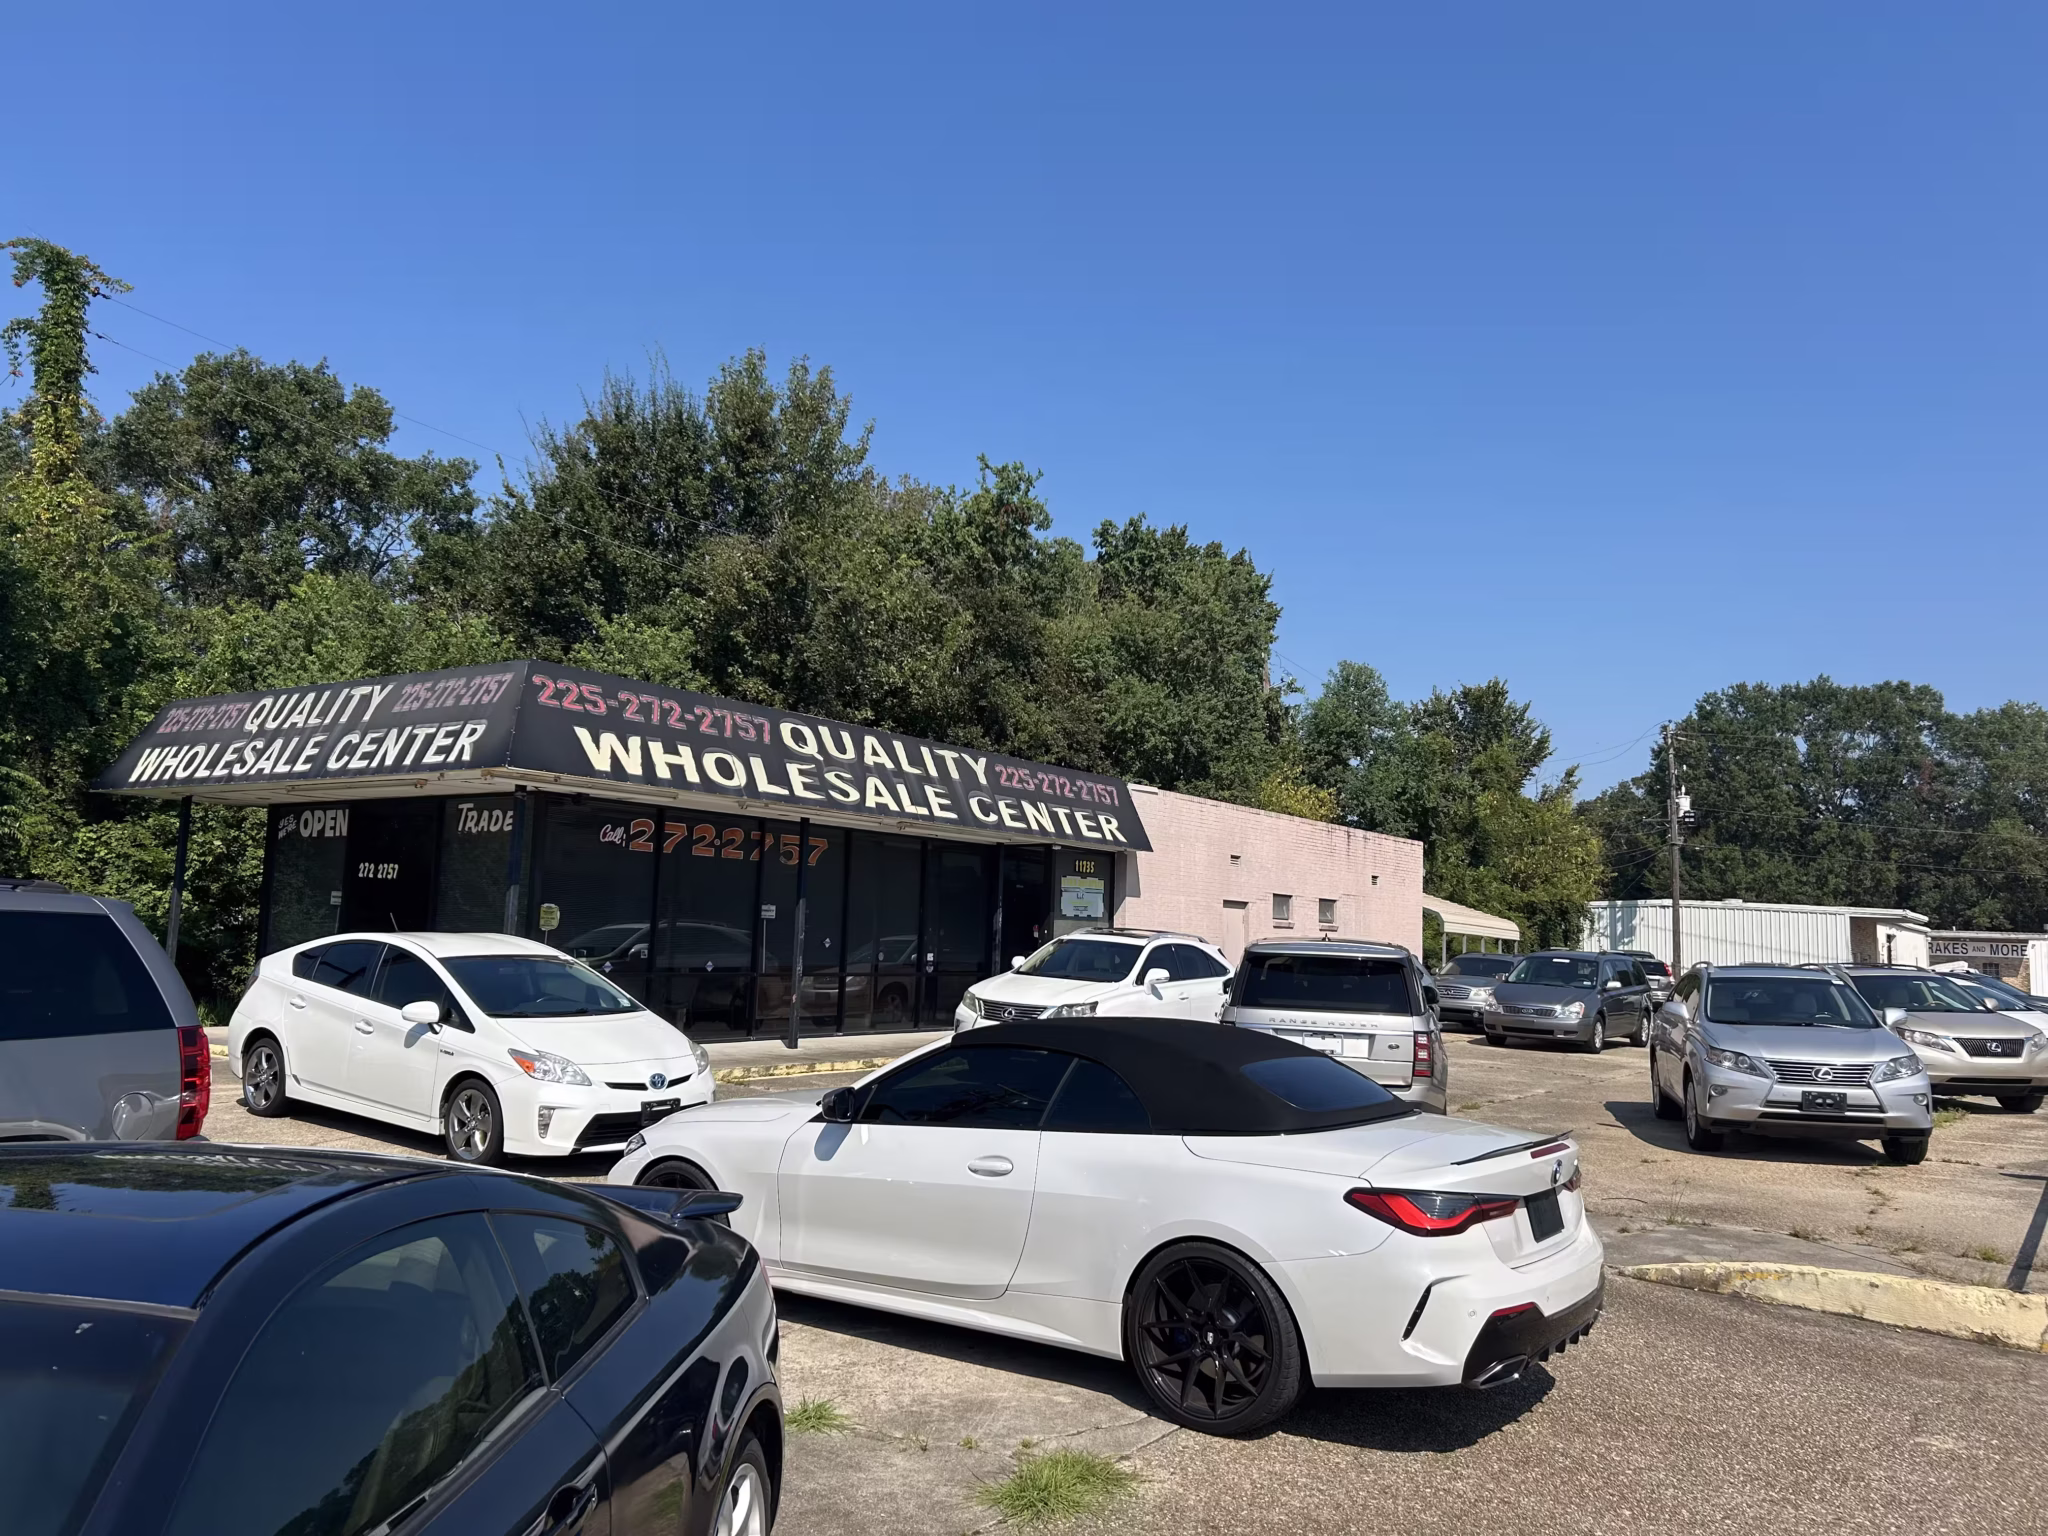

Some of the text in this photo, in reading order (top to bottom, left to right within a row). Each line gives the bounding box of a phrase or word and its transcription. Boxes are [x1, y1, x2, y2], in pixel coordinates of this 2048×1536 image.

[157, 672, 515, 734] 225-272-2757 QUALITY 225-272-2757
[129, 719, 488, 783] WHOLESALE CENTER
[532, 673, 1121, 807] 225-272-2757 QUALITY 225-272-2757
[573, 725, 1128, 843] WHOLESALE CENTER
[300, 809, 349, 838] OPEN
[458, 803, 514, 833] TRADE
[358, 862, 399, 879] 272 2757
[1971, 945, 1986, 953] AND
[1989, 943, 2028, 957] MORE
[1268, 1017, 1318, 1025] RANGE
